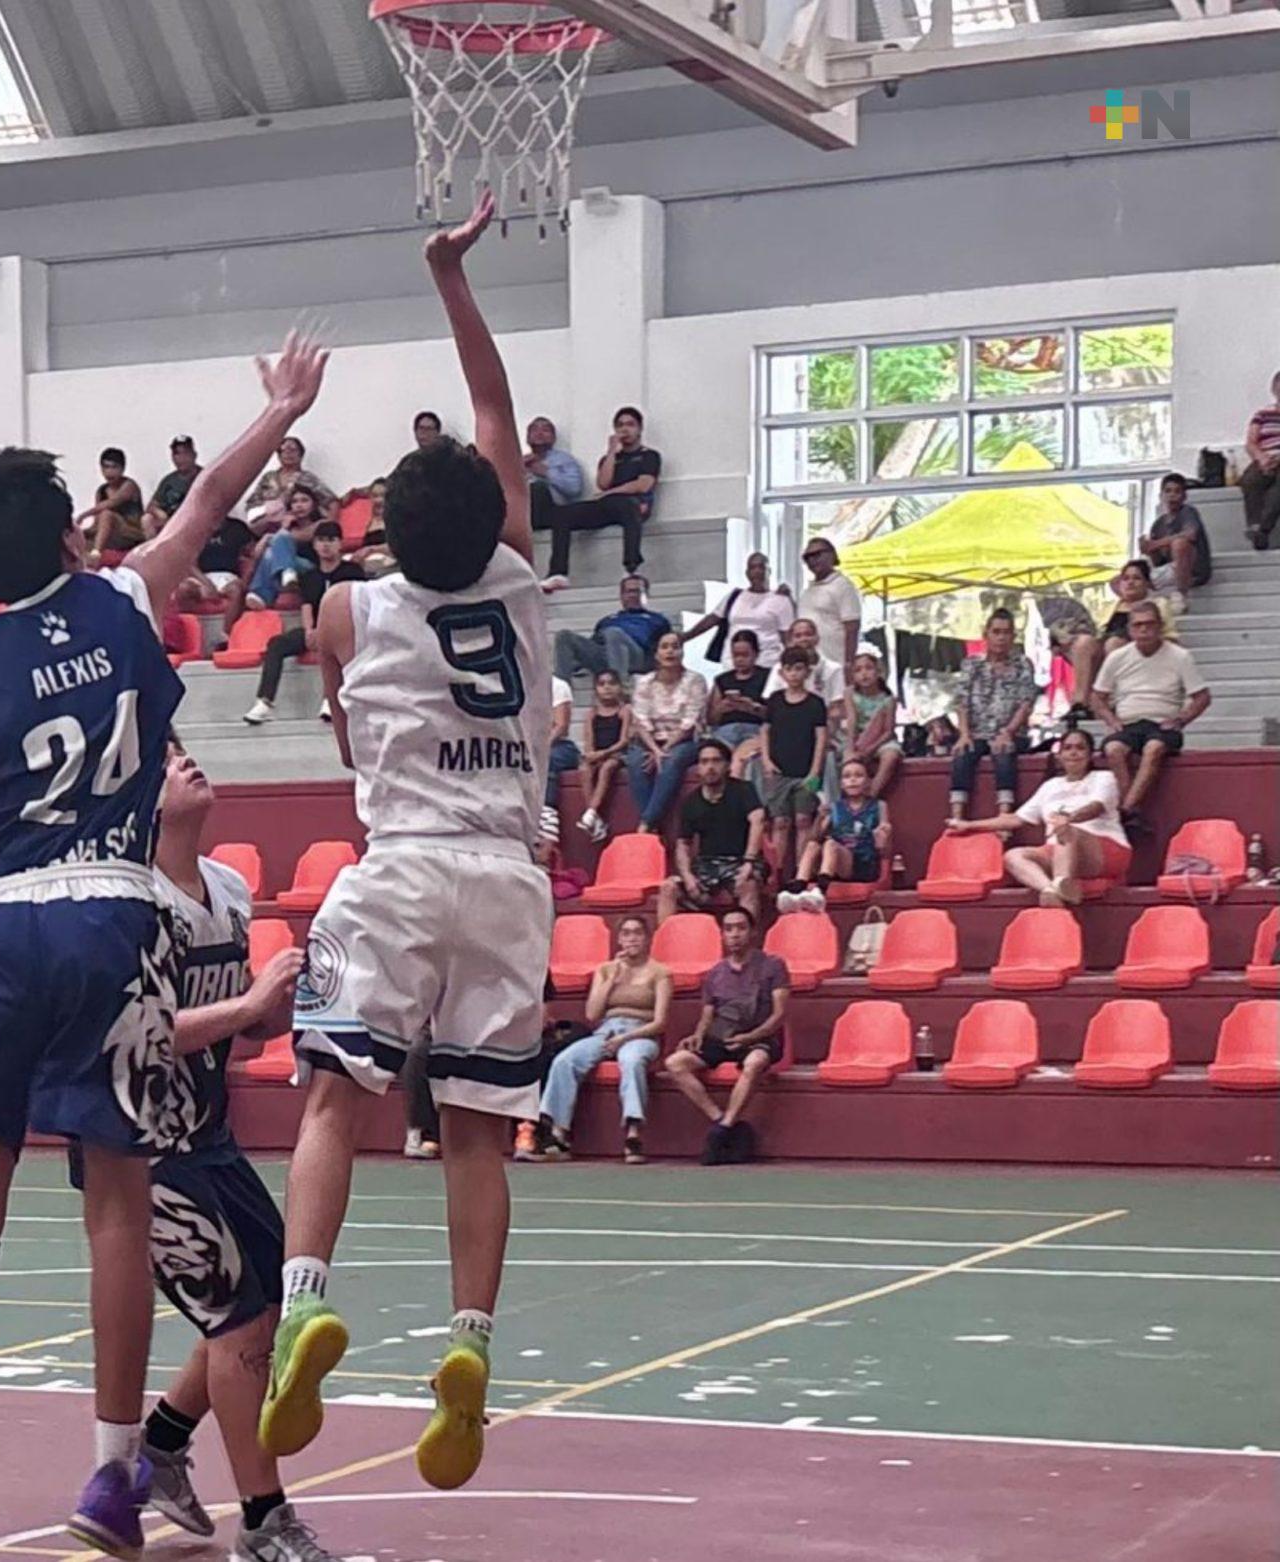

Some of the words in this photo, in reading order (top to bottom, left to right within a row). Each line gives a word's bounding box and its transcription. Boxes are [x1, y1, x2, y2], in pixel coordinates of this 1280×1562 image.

[32, 647, 113, 699] ALEXIS
[425, 598, 525, 718] 9
[20, 689, 140, 825] 24
